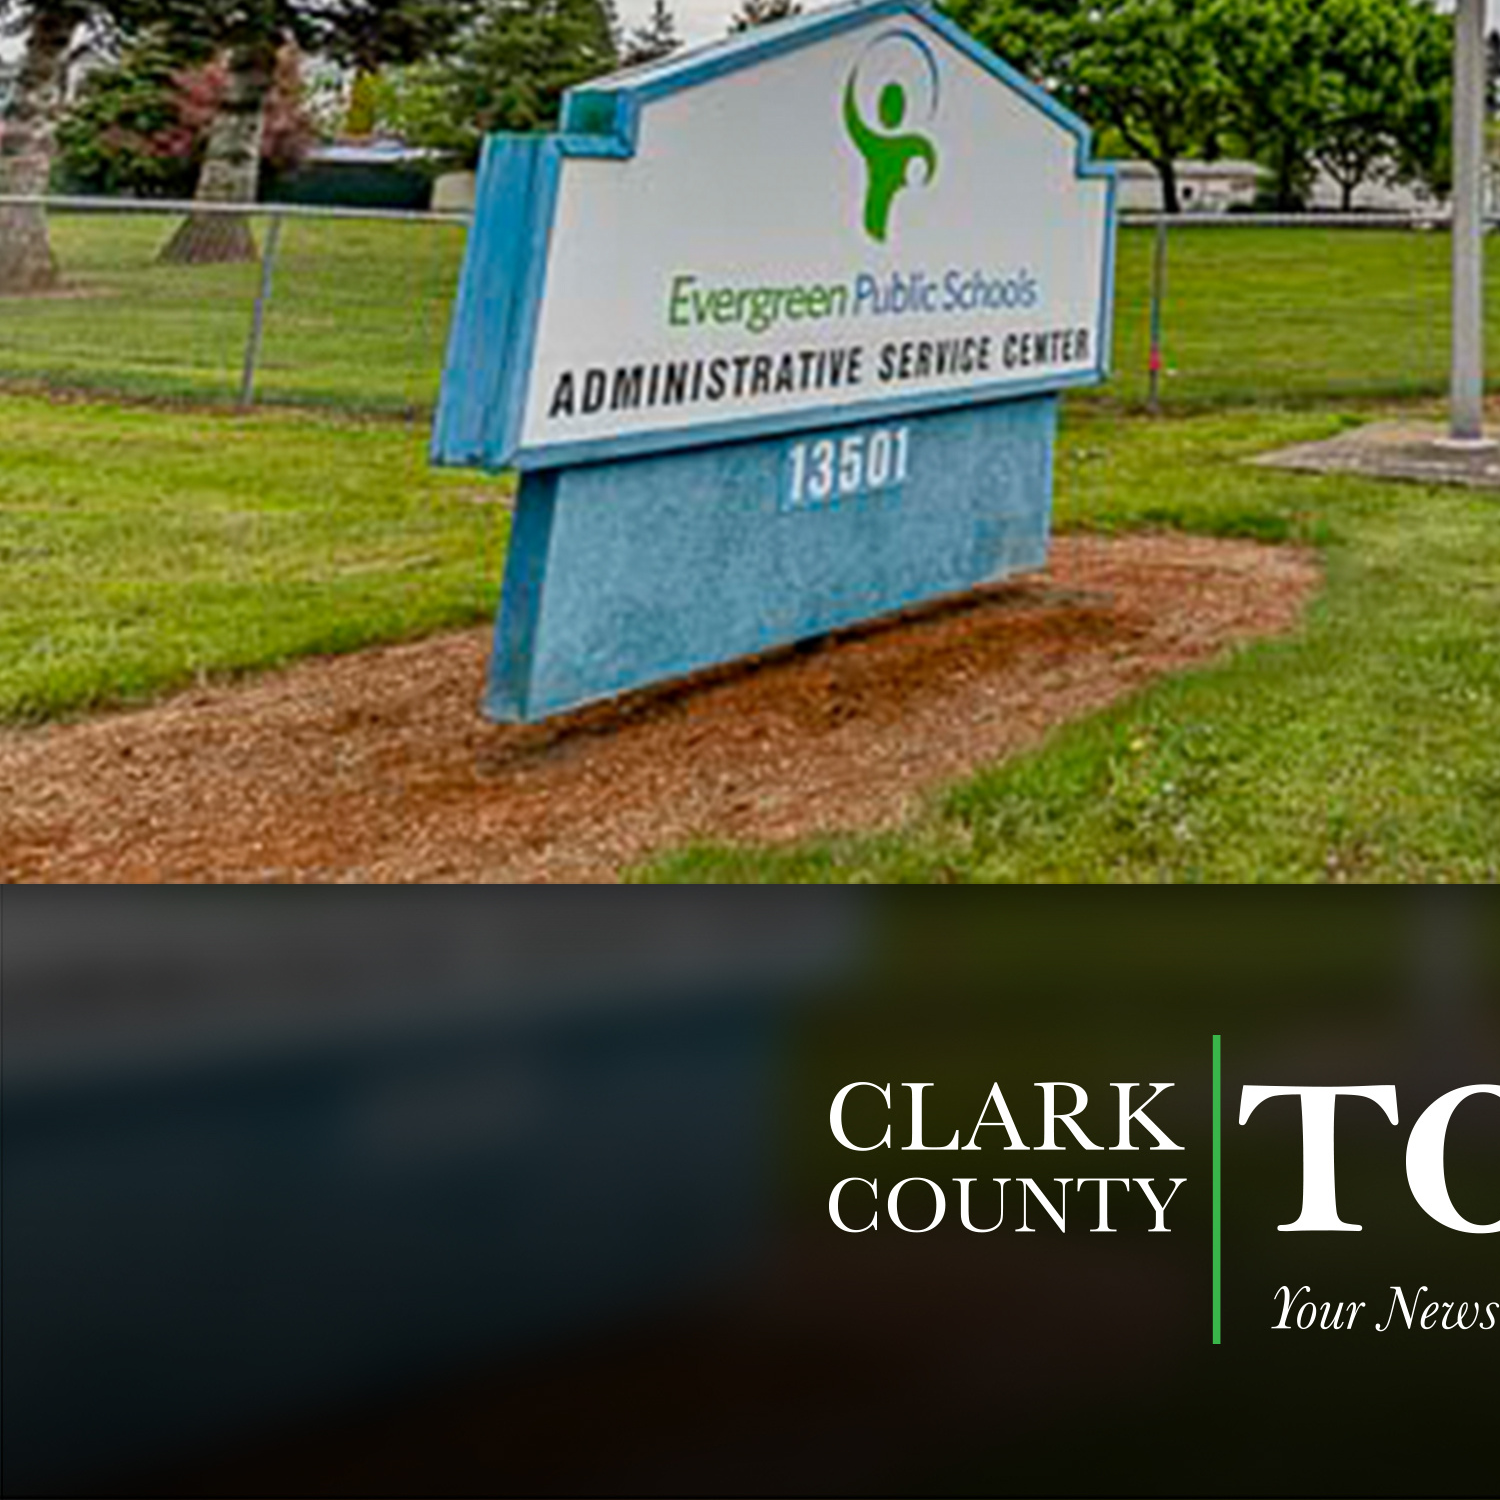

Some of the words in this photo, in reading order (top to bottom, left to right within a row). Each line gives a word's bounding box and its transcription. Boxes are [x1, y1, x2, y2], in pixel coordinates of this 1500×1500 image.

[668, 274, 847, 333] Evergreen
[852, 272, 937, 316] Public
[942, 268, 1037, 312] Schools
[549, 346, 863, 418] ADMINISTRATIVE
[877, 336, 990, 383] SERVICE
[1002, 328, 1089, 369] CENTER
[786, 428, 908, 500] 13501
